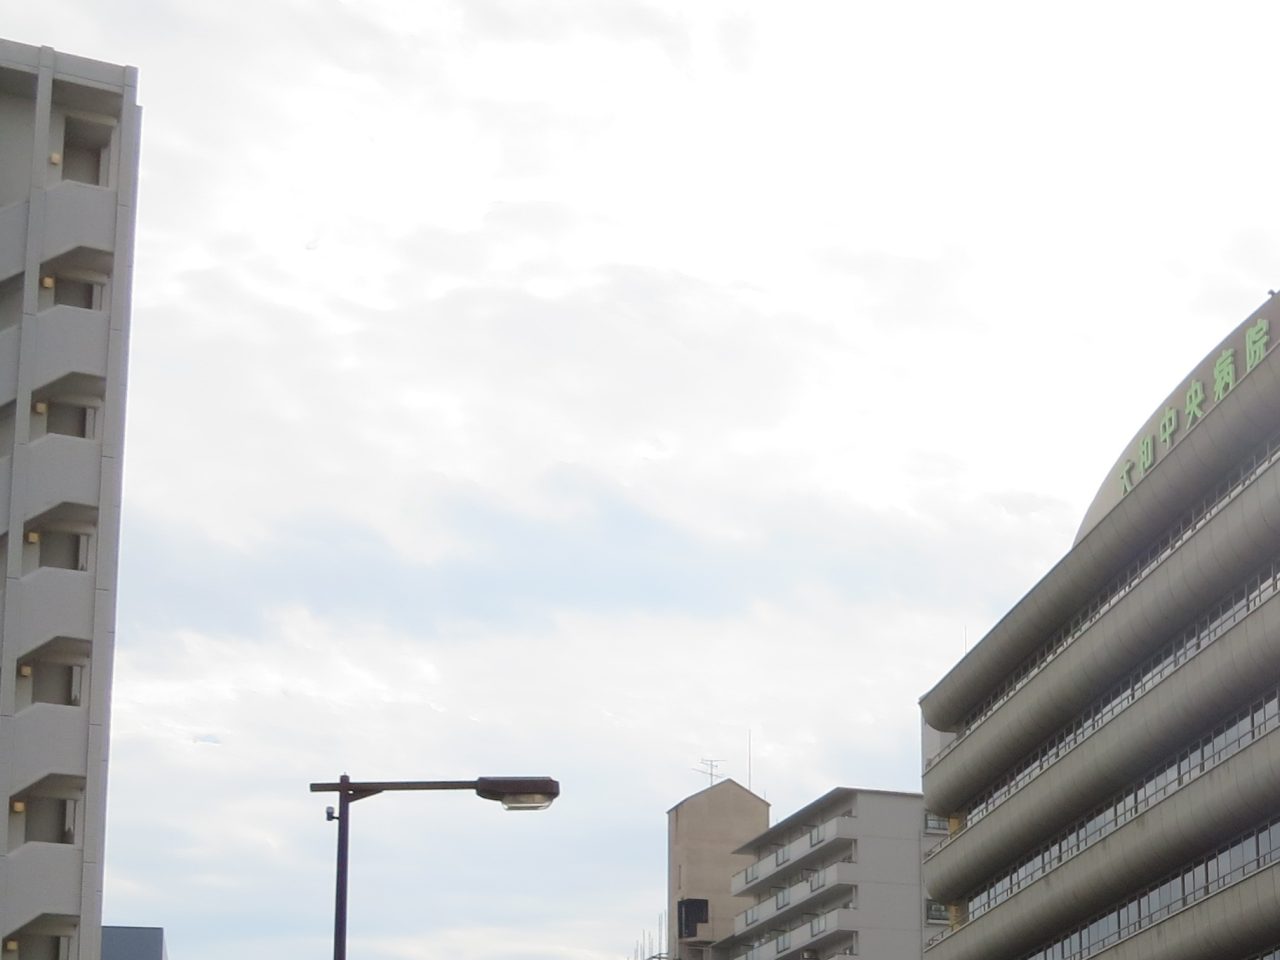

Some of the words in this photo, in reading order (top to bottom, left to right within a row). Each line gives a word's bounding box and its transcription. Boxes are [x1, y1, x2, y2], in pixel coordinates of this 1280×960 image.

[1118, 318, 1271, 497] 大和中央病院
